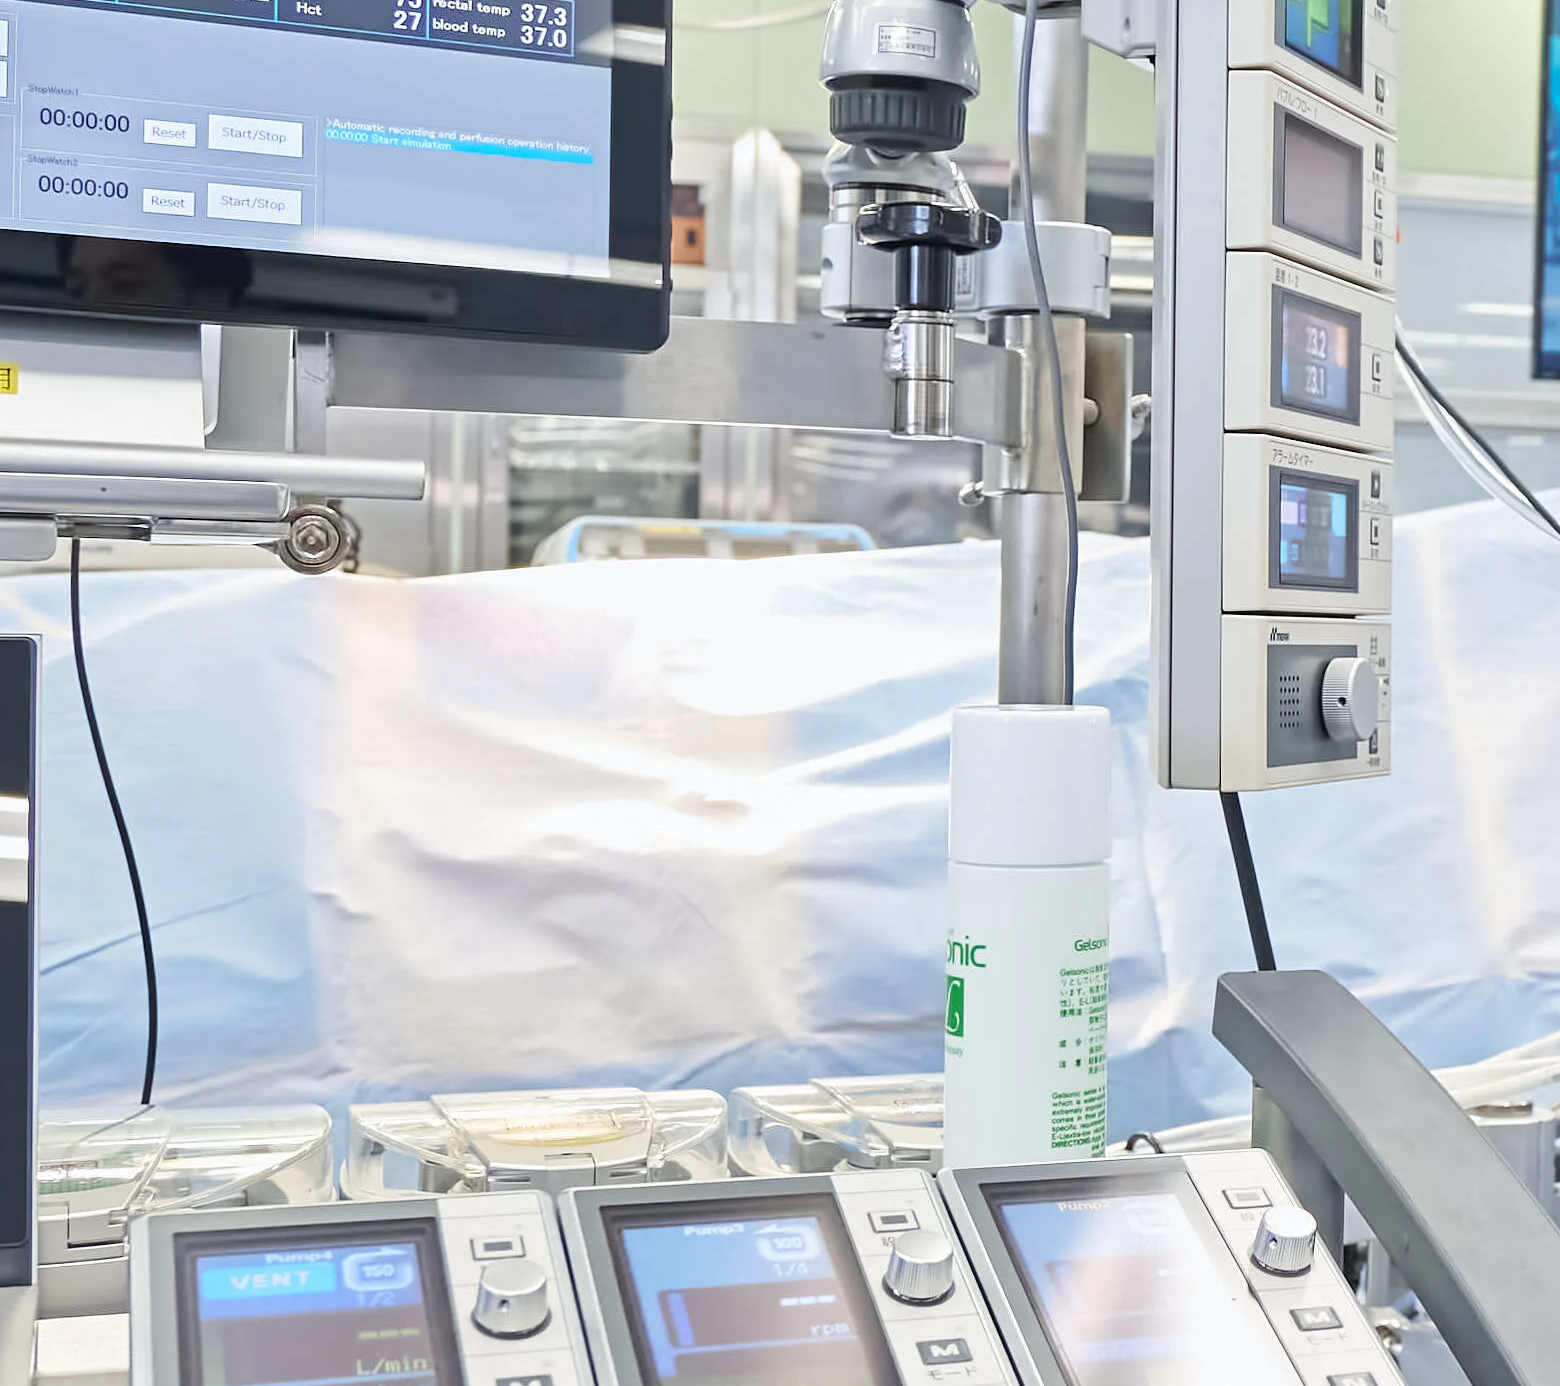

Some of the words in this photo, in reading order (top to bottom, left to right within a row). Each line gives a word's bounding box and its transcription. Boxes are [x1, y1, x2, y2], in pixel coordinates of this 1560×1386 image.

[296, 0, 323, 17] Hct
[393, 10, 422, 31] 27
[477, 1, 511, 18] temp
[520, 3, 567, 27] 37.3
[432, 19, 469, 34] blood
[472, 22, 506, 38] temp
[520, 25, 567, 48] 37.0
[40, 107, 130, 133] 00:00:00
[151, 125, 187, 140] Reset
[221, 126, 287, 145] Start/Stop
[389, 125, 436, 140] recording
[438, 130, 457, 141] and
[460, 131, 505, 147] perfusion
[507, 137, 554, 152] operation
[371, 134, 399, 147] Start
[401, 136, 452, 151] simulation
[38, 174, 129, 199] 00:00:00
[151, 195, 185, 209] Reset
[220, 194, 286, 212] Start/Stop
[684, 1223, 745, 1237] Pump3
[229, 1270, 312, 1291] VENT
[361, 1264, 395, 1279] 150
[811, 1322, 851, 1337] rpm
[356, 1356, 428, 1376] L/min
[927, 1366, 978, 1381] モード
